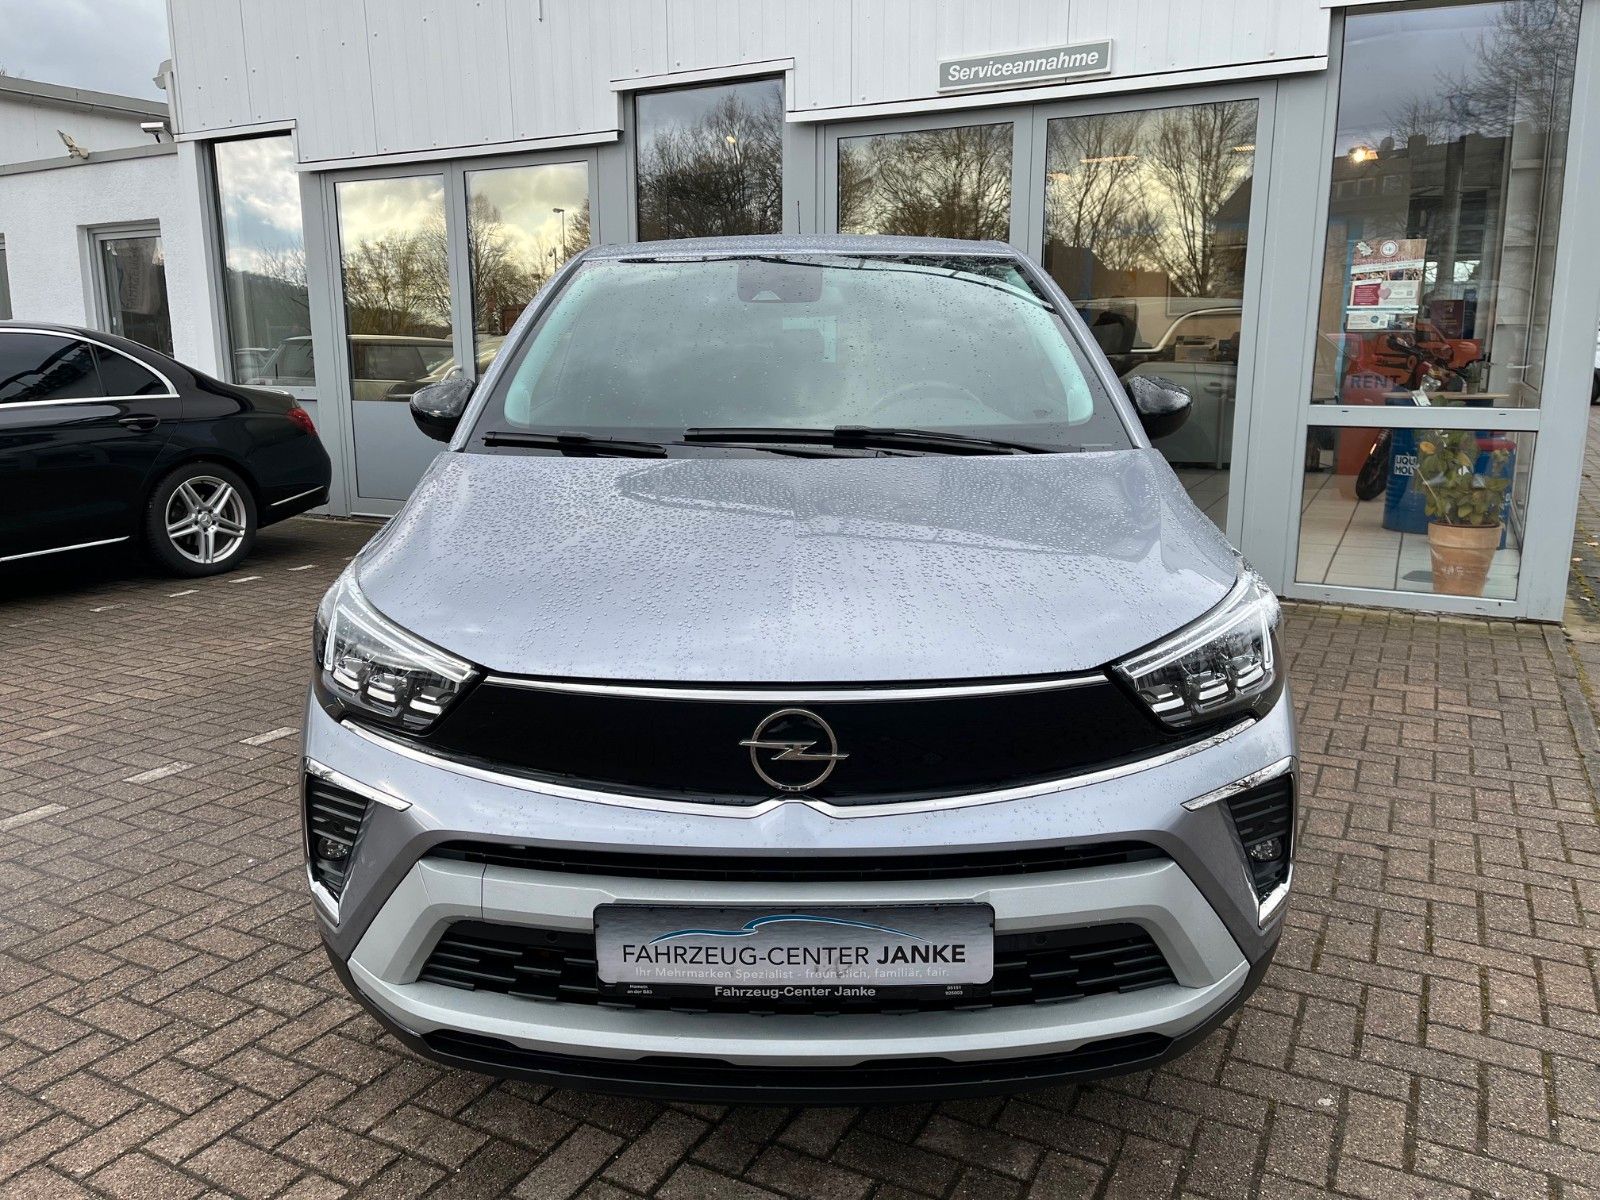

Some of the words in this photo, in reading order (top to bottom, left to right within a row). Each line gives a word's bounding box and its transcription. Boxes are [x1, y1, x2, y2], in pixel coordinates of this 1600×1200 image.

[948, 51, 1100, 81] Serviceannahme
[1350, 374, 1402, 389] RENT
[622, 944, 870, 966] FAHRZEUG-CENTER
[876, 944, 967, 965] JANKE
[635, 966, 651, 977] Ihr
[655, 967, 732, 979] Mehrmarken
[735, 968, 793, 981] Spezialist
[927, 967, 950, 977] fair.
[714, 986, 831, 999] Fahrzeug-Center
[834, 986, 876, 997] Janke
